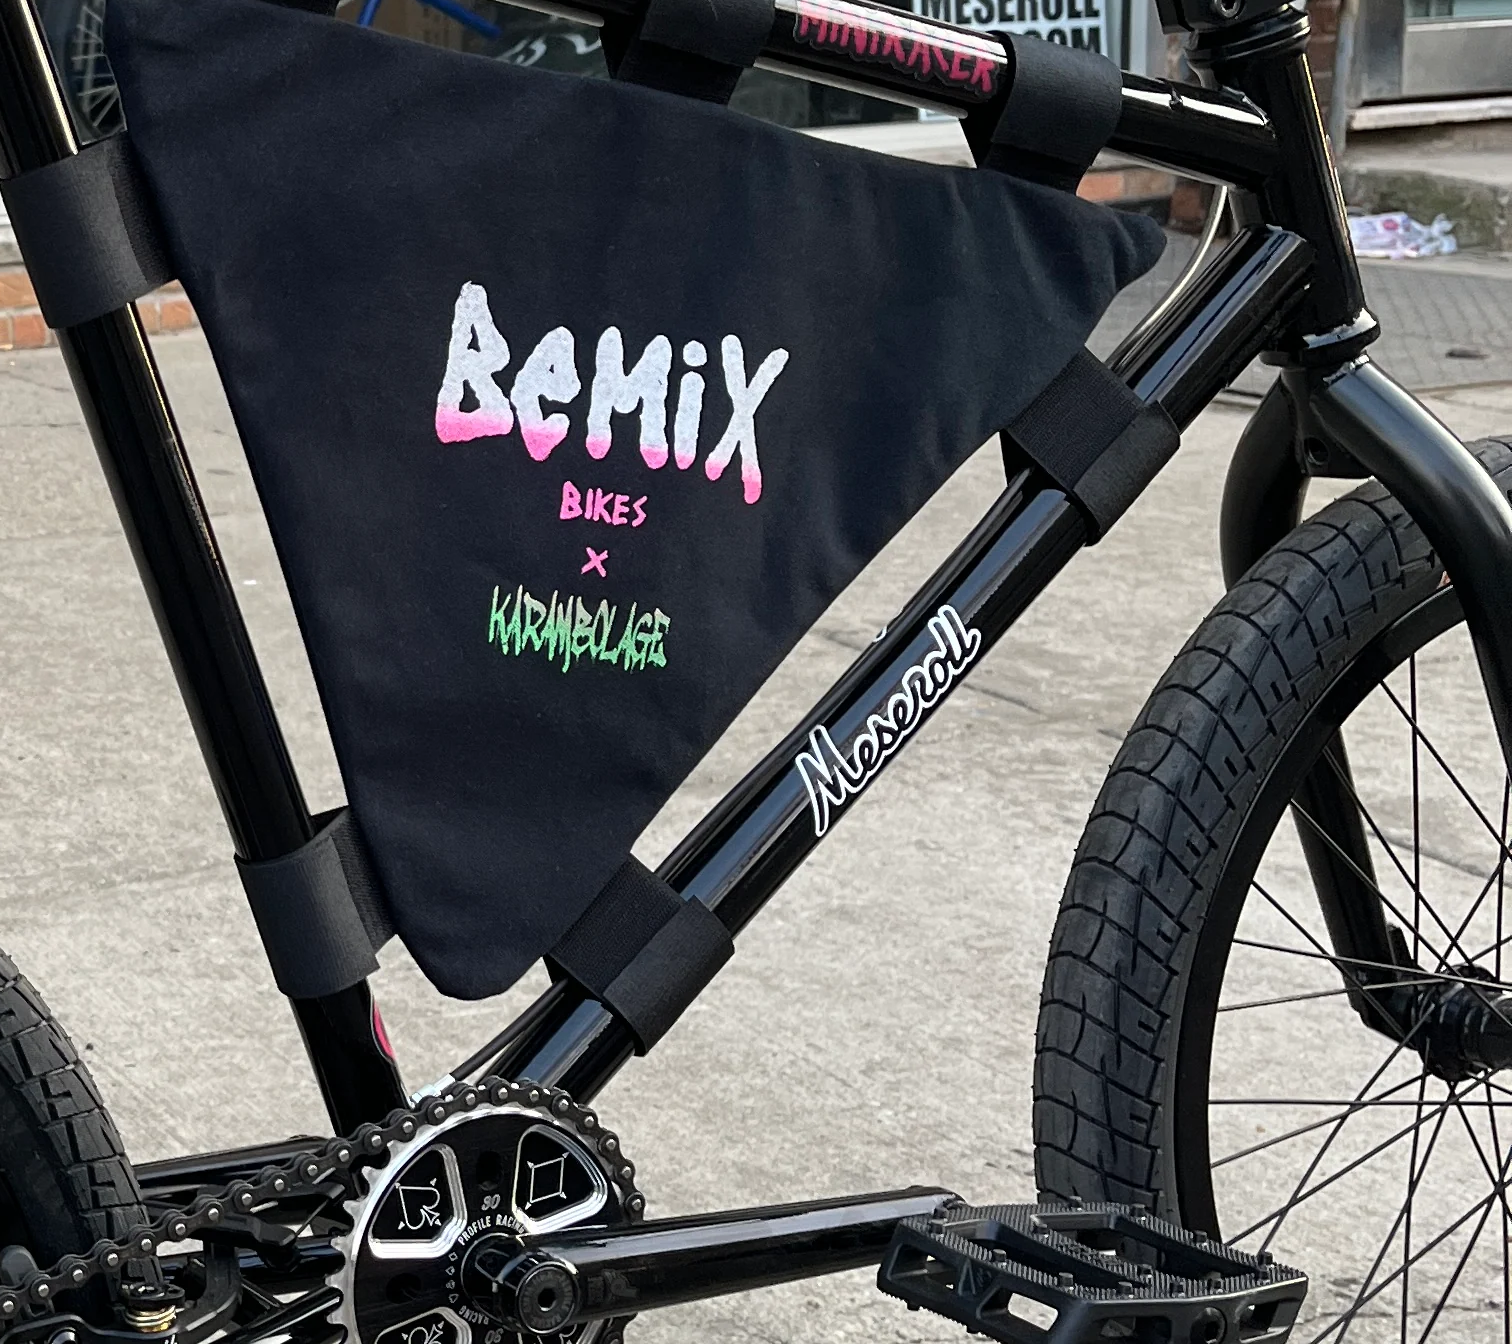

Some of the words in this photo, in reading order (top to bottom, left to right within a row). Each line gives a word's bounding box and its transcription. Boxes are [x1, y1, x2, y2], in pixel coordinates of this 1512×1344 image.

[559, 480, 648, 527] BIKES
[795, 604, 982, 837] Meseroll
[457, 1213, 492, 1247] PROFILE
